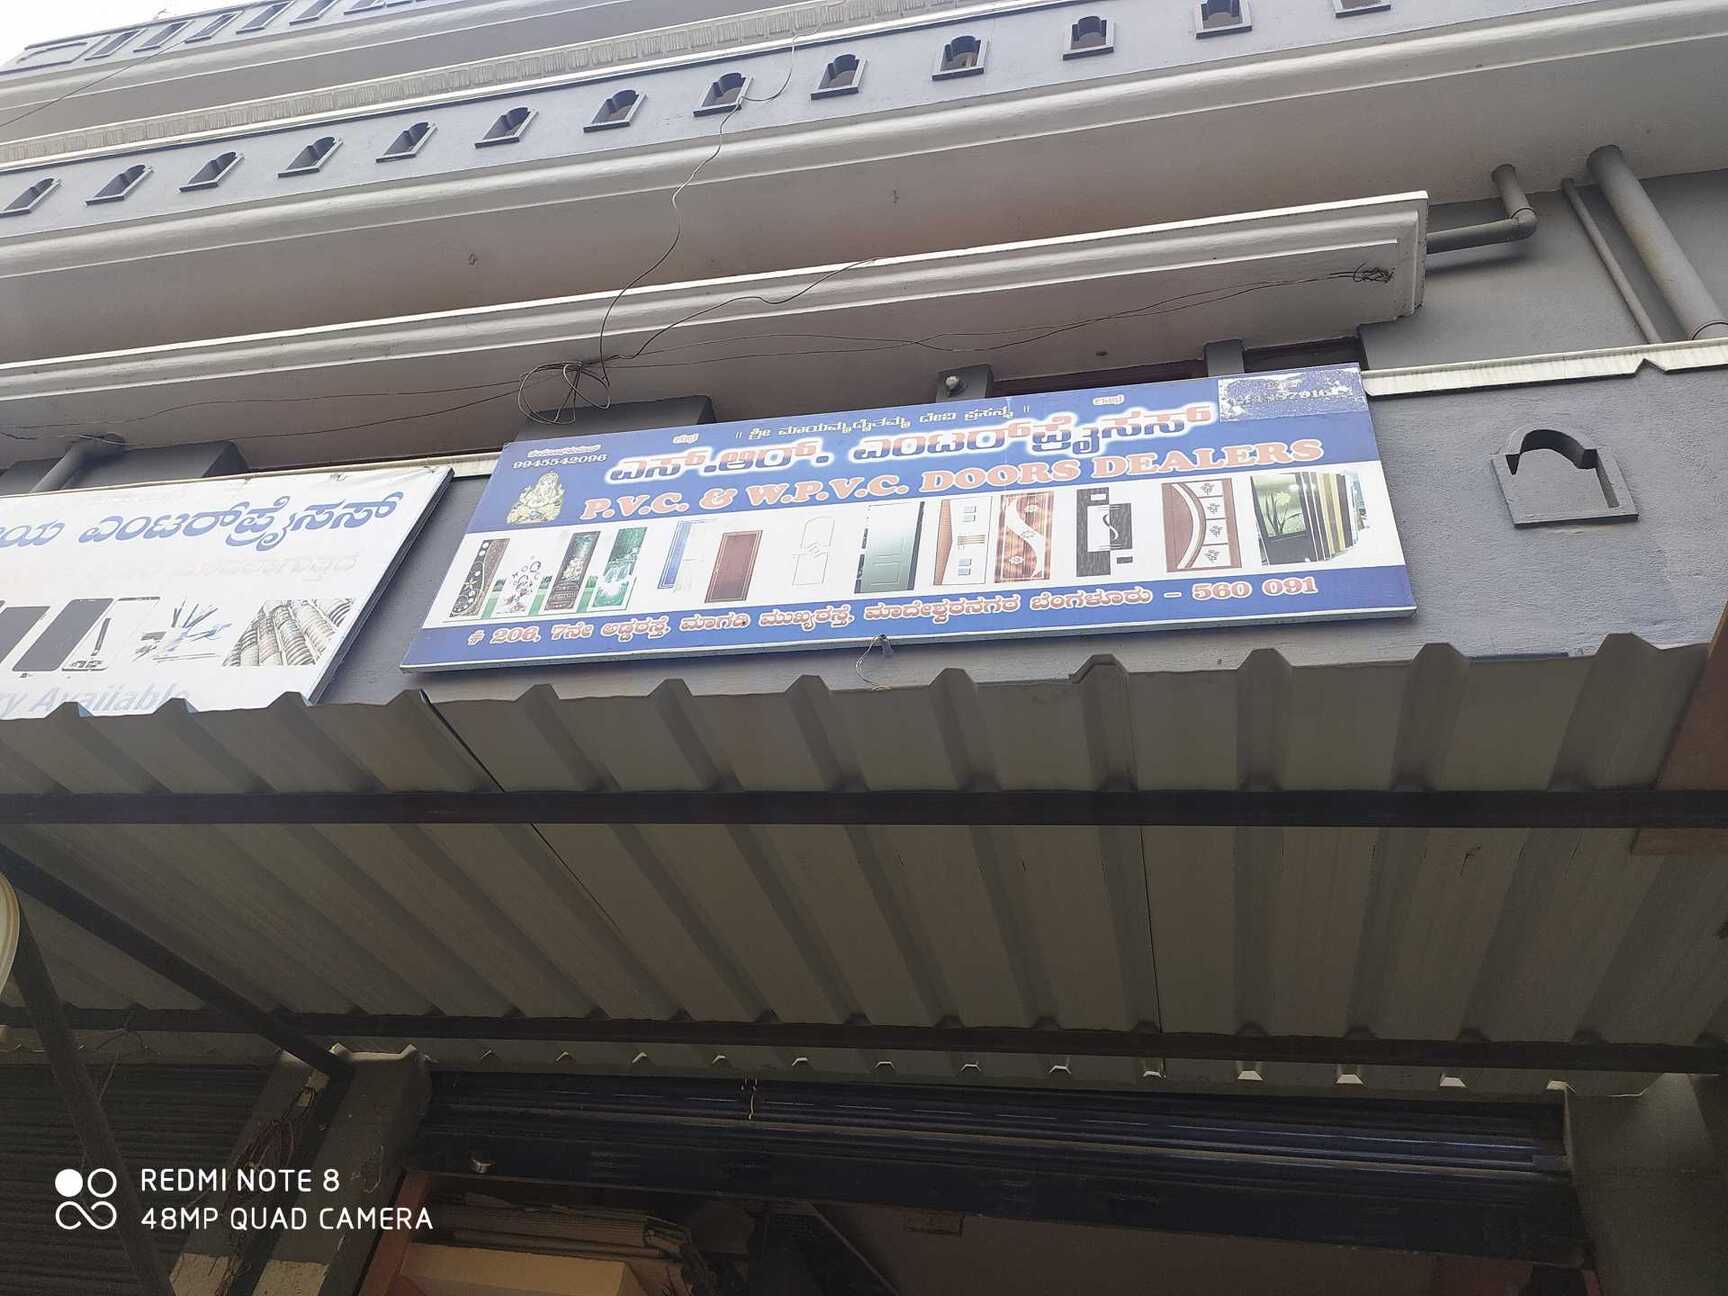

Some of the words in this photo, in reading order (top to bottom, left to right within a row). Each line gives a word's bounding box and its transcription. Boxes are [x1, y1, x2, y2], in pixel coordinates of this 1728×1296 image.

[580, 491, 690, 520] P.V.C.
[699, 488, 738, 509] &
[746, 474, 910, 507] W.P.V.C.
[919, 458, 1081, 492] DOORS
[1091, 438, 1325, 478] DEALERS
[1029, 584, 1152, 610] ಬೆಂಗಳೂರು
[1192, 581, 1252, 600] 560
[1262, 576, 1318, 595] 091
